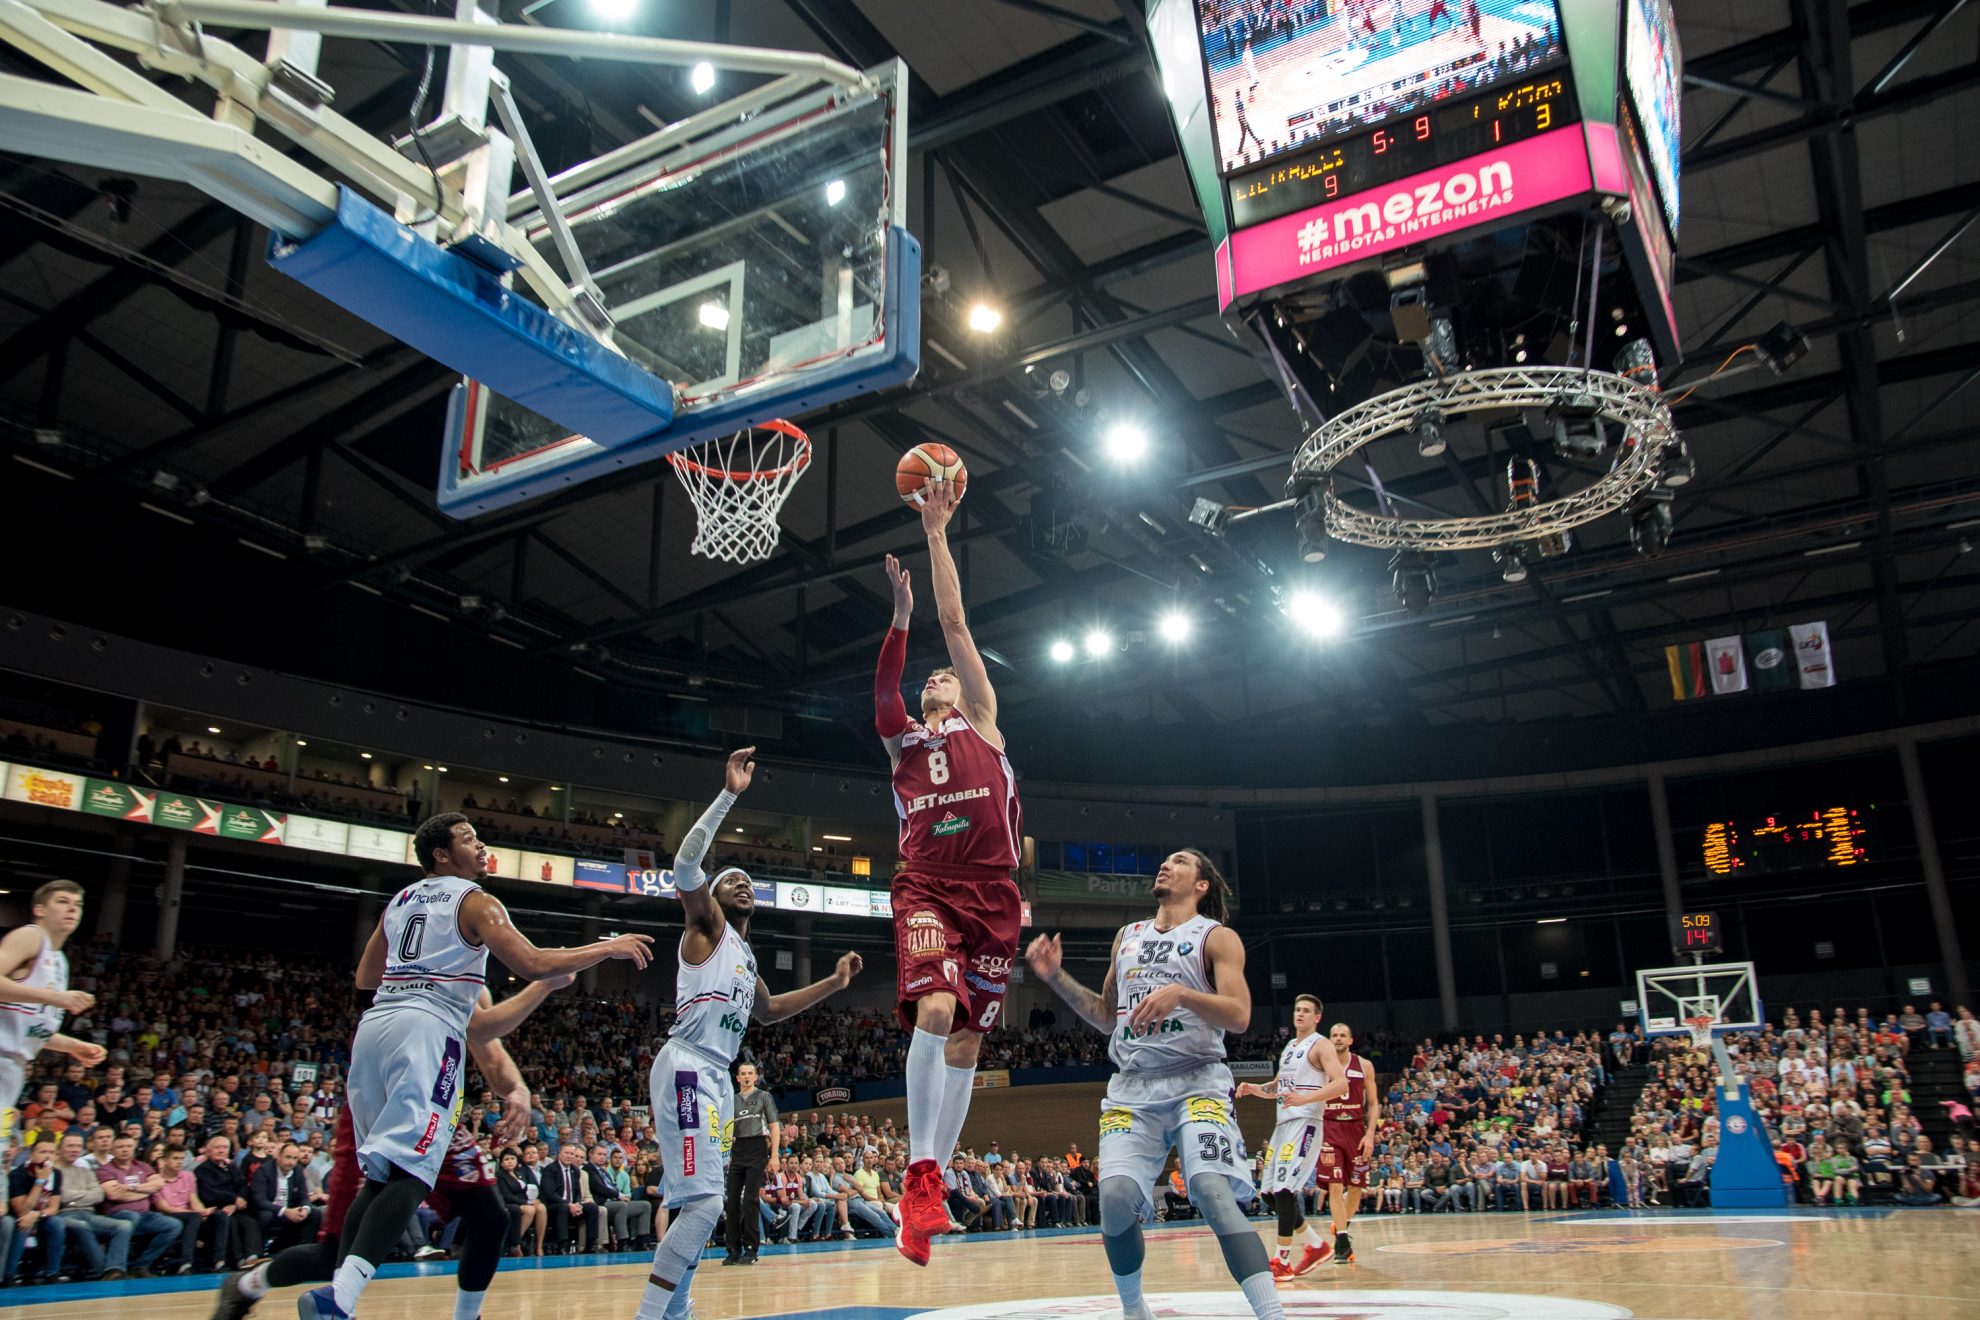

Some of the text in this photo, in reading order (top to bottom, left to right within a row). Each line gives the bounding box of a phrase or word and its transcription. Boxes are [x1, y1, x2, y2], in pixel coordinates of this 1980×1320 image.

[1536, 103, 1550, 129] 3
[1324, 174, 1338, 198] 9
[1297, 160, 1513, 251] #mezon
[1300, 187, 1514, 267] NERIBOTAS INTERNETAS
[927, 750, 950, 785] 8
[907, 787, 991, 814] LIET KABELIS
[932, 819, 970, 836] Kalnapilis
[1088, 873, 1138, 895] Party
[398, 913, 428, 963] 0
[1687, 929, 1707, 945] 14
[1138, 940, 1174, 964] 32
[979, 1000, 1000, 1028] 8
[1284, 1051, 1293, 1064] 2
[820, 1090, 848, 1100] TORRIDO
[1198, 1133, 1233, 1166] 32
[1277, 1167, 1287, 1182] 2
